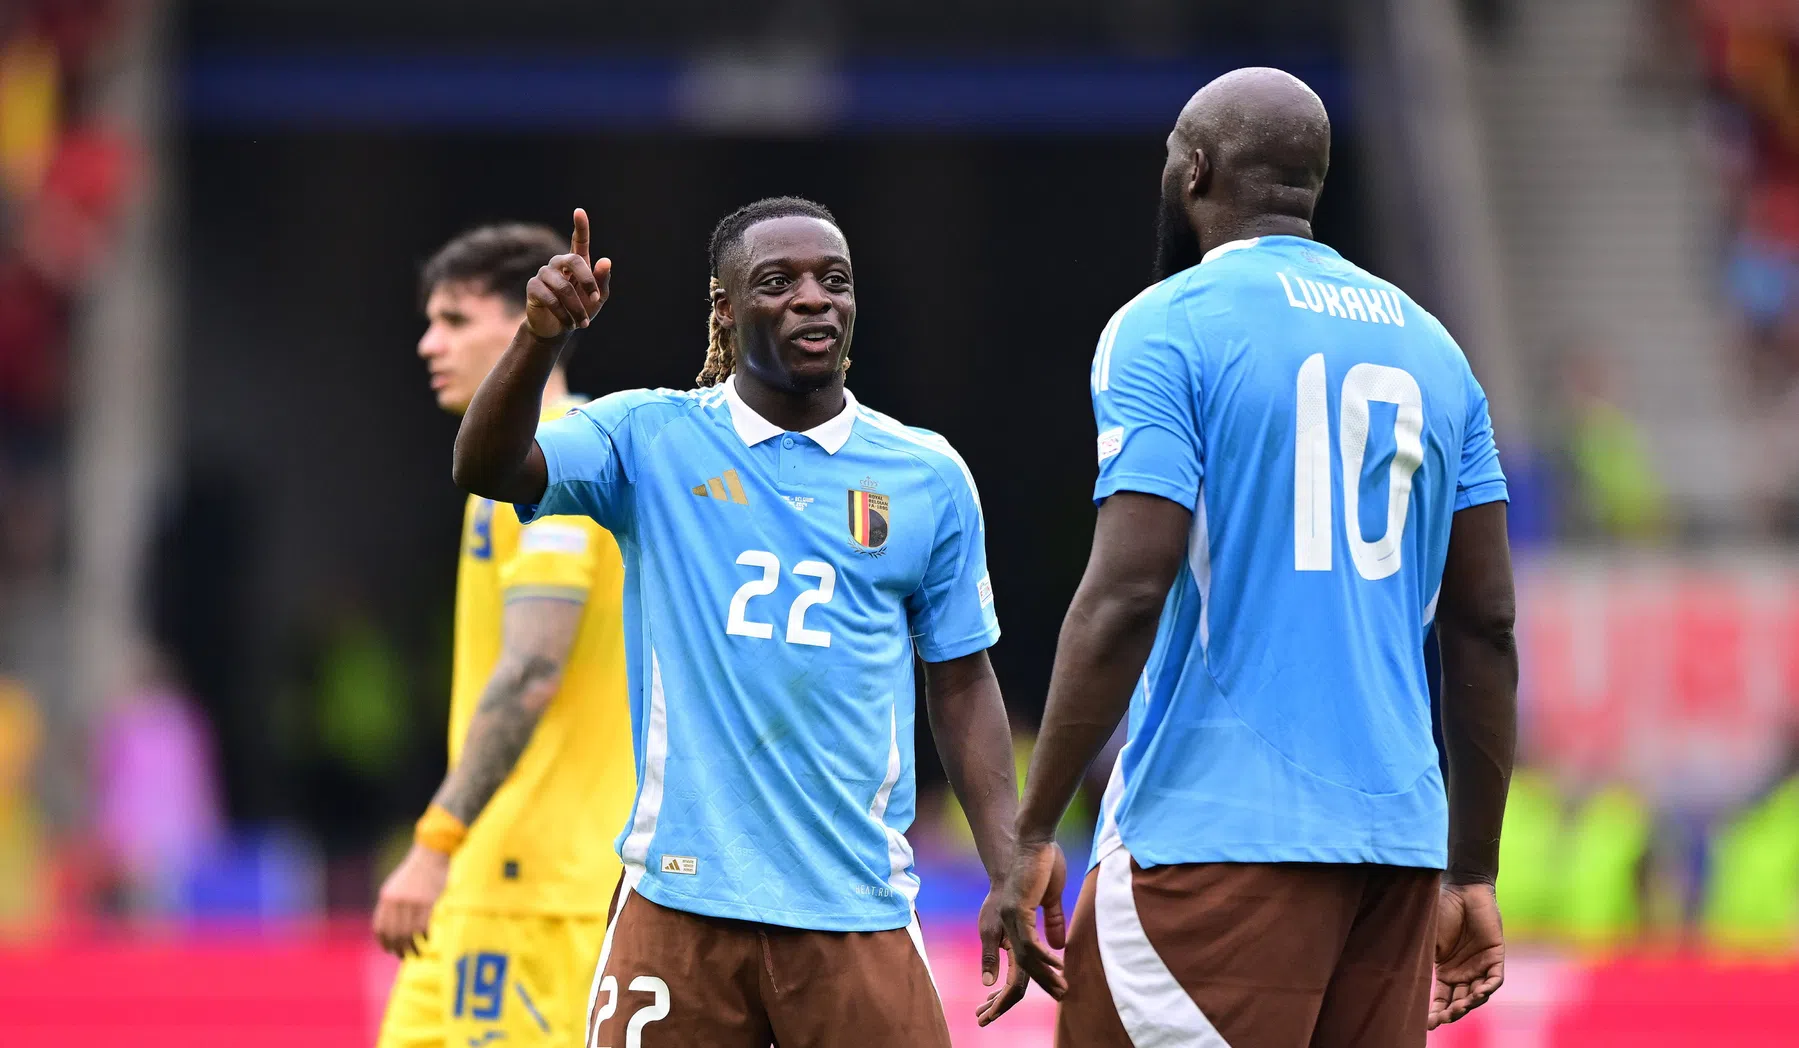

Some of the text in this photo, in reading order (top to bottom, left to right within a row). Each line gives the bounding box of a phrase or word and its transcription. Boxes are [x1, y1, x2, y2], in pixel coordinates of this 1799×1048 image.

[1276, 272, 1405, 327] LUKAKU
[1294, 353, 1423, 580] 10
[726, 550, 836, 648] 22
[453, 952, 509, 1021] 19
[591, 975, 671, 1048] 22
